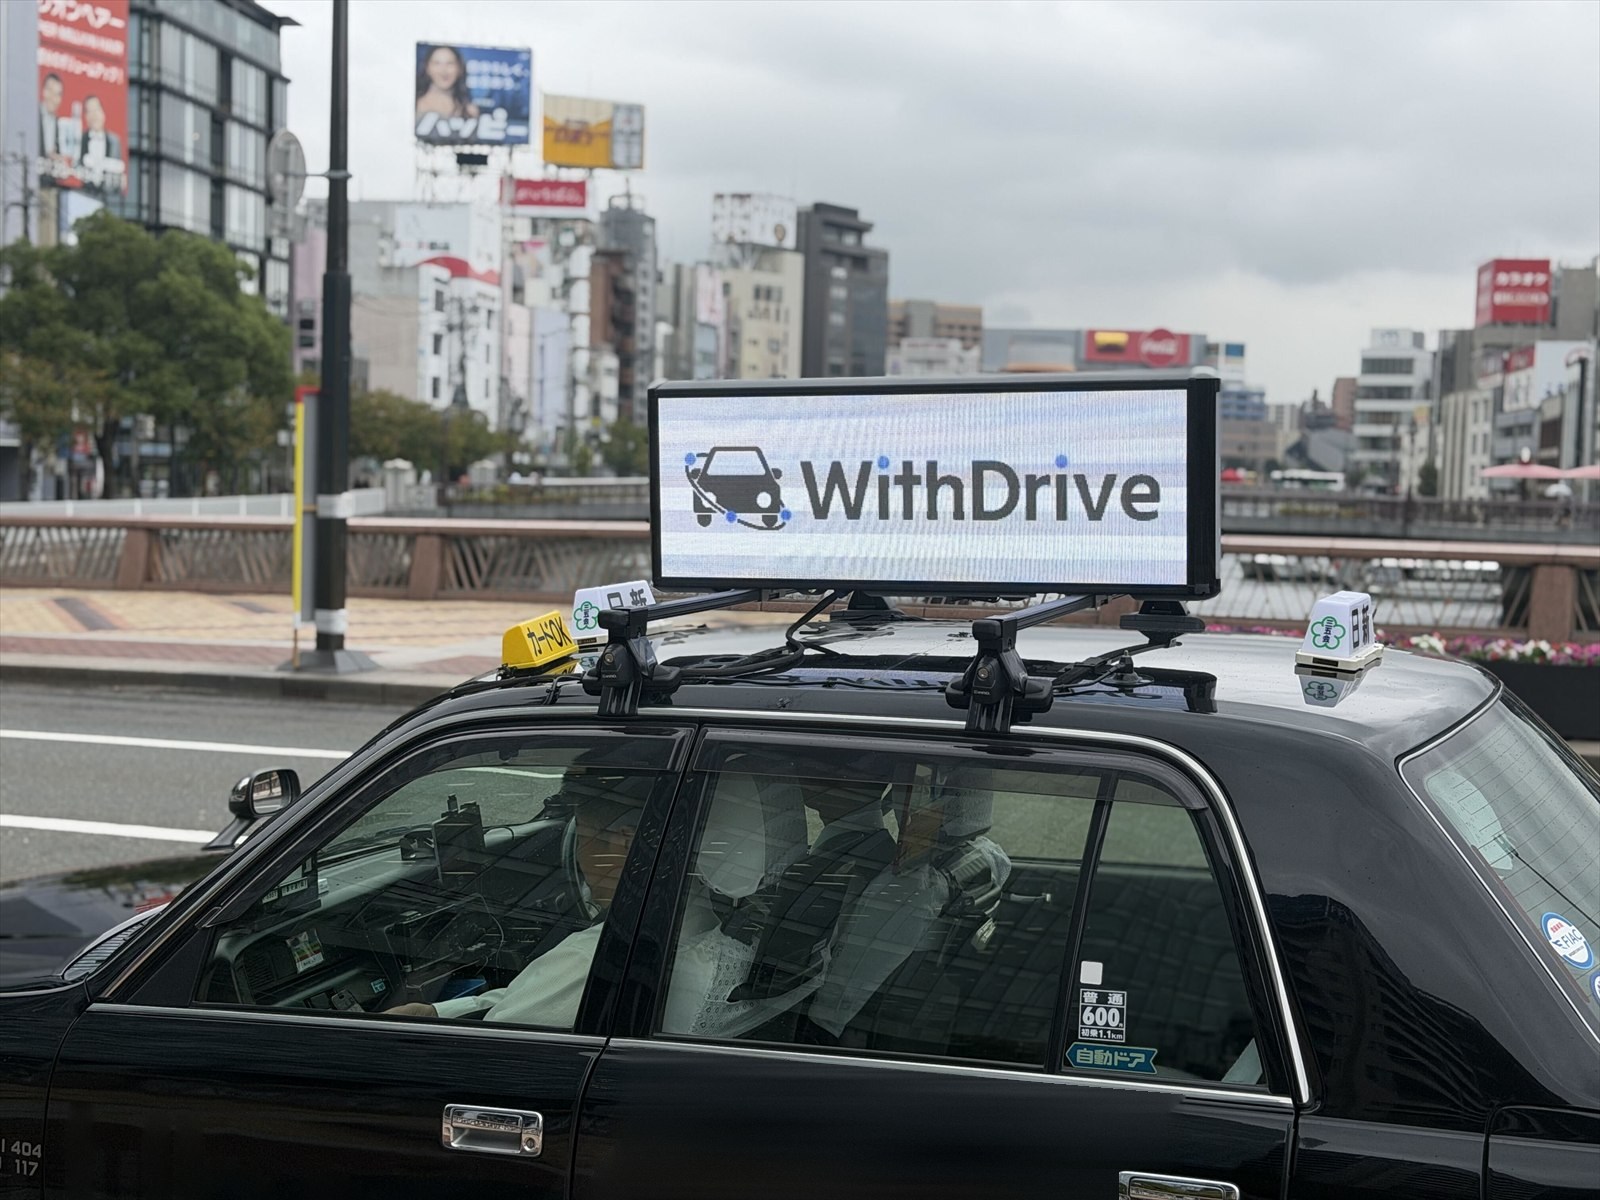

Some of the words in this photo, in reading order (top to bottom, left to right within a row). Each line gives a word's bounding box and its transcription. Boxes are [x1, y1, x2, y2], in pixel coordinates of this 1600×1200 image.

[800, 455, 1161, 521] WithDrive
[526, 616, 573, 657] カードOK
[1083, 991, 1123, 1005] 普通
[1076, 1047, 1145, 1068] 自動ドア
